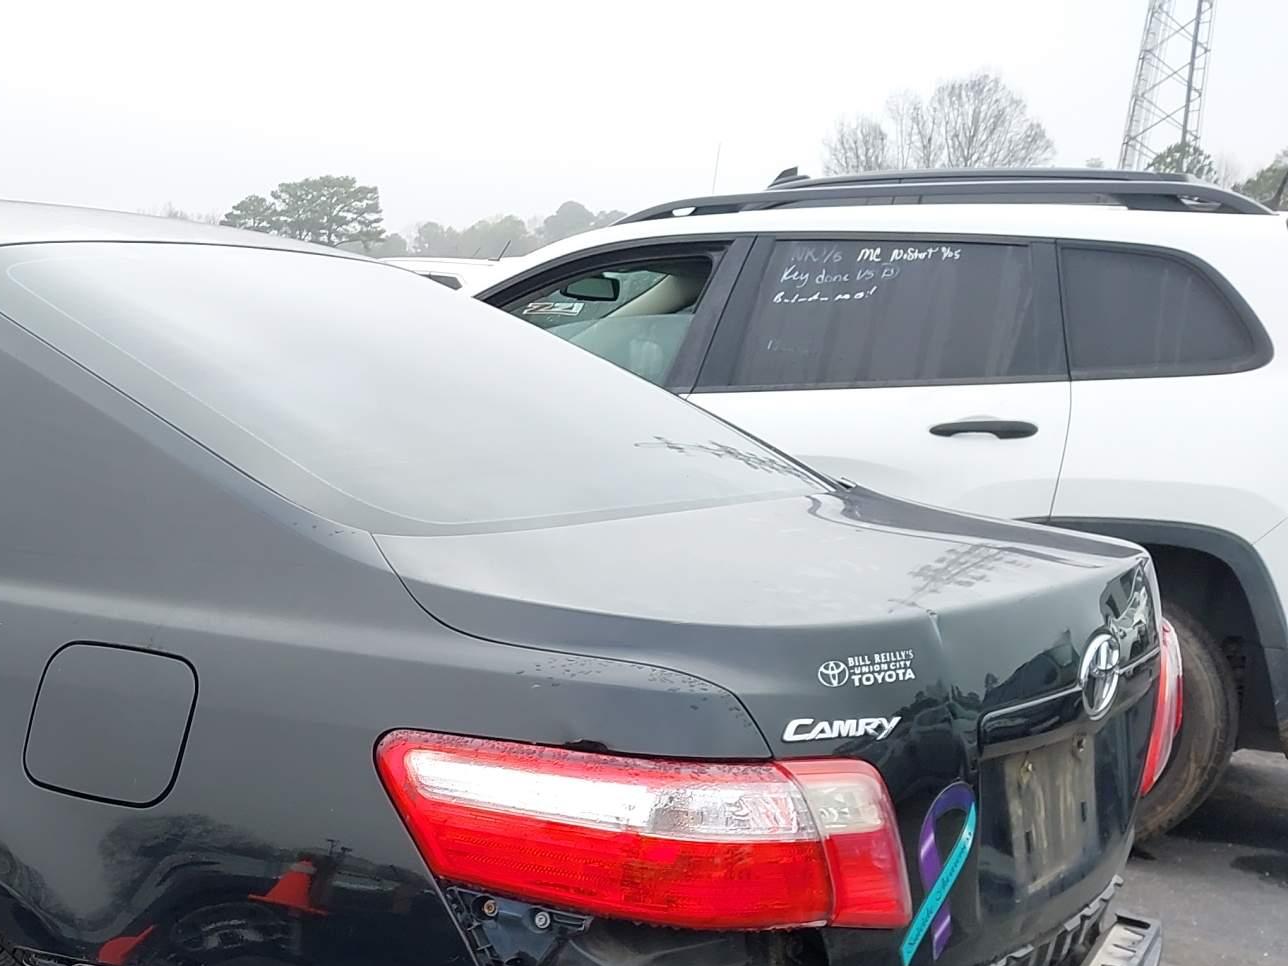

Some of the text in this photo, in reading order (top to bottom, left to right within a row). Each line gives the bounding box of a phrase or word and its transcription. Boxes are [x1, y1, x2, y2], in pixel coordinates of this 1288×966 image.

[780, 264, 810, 289] Key
[815, 268, 850, 284] done
[847, 649, 914, 667] BILL REILLY'S
[889, 660, 912, 670] CITY
[850, 668, 916, 687] TOYOTA
[781, 715, 903, 742] CAMRY
